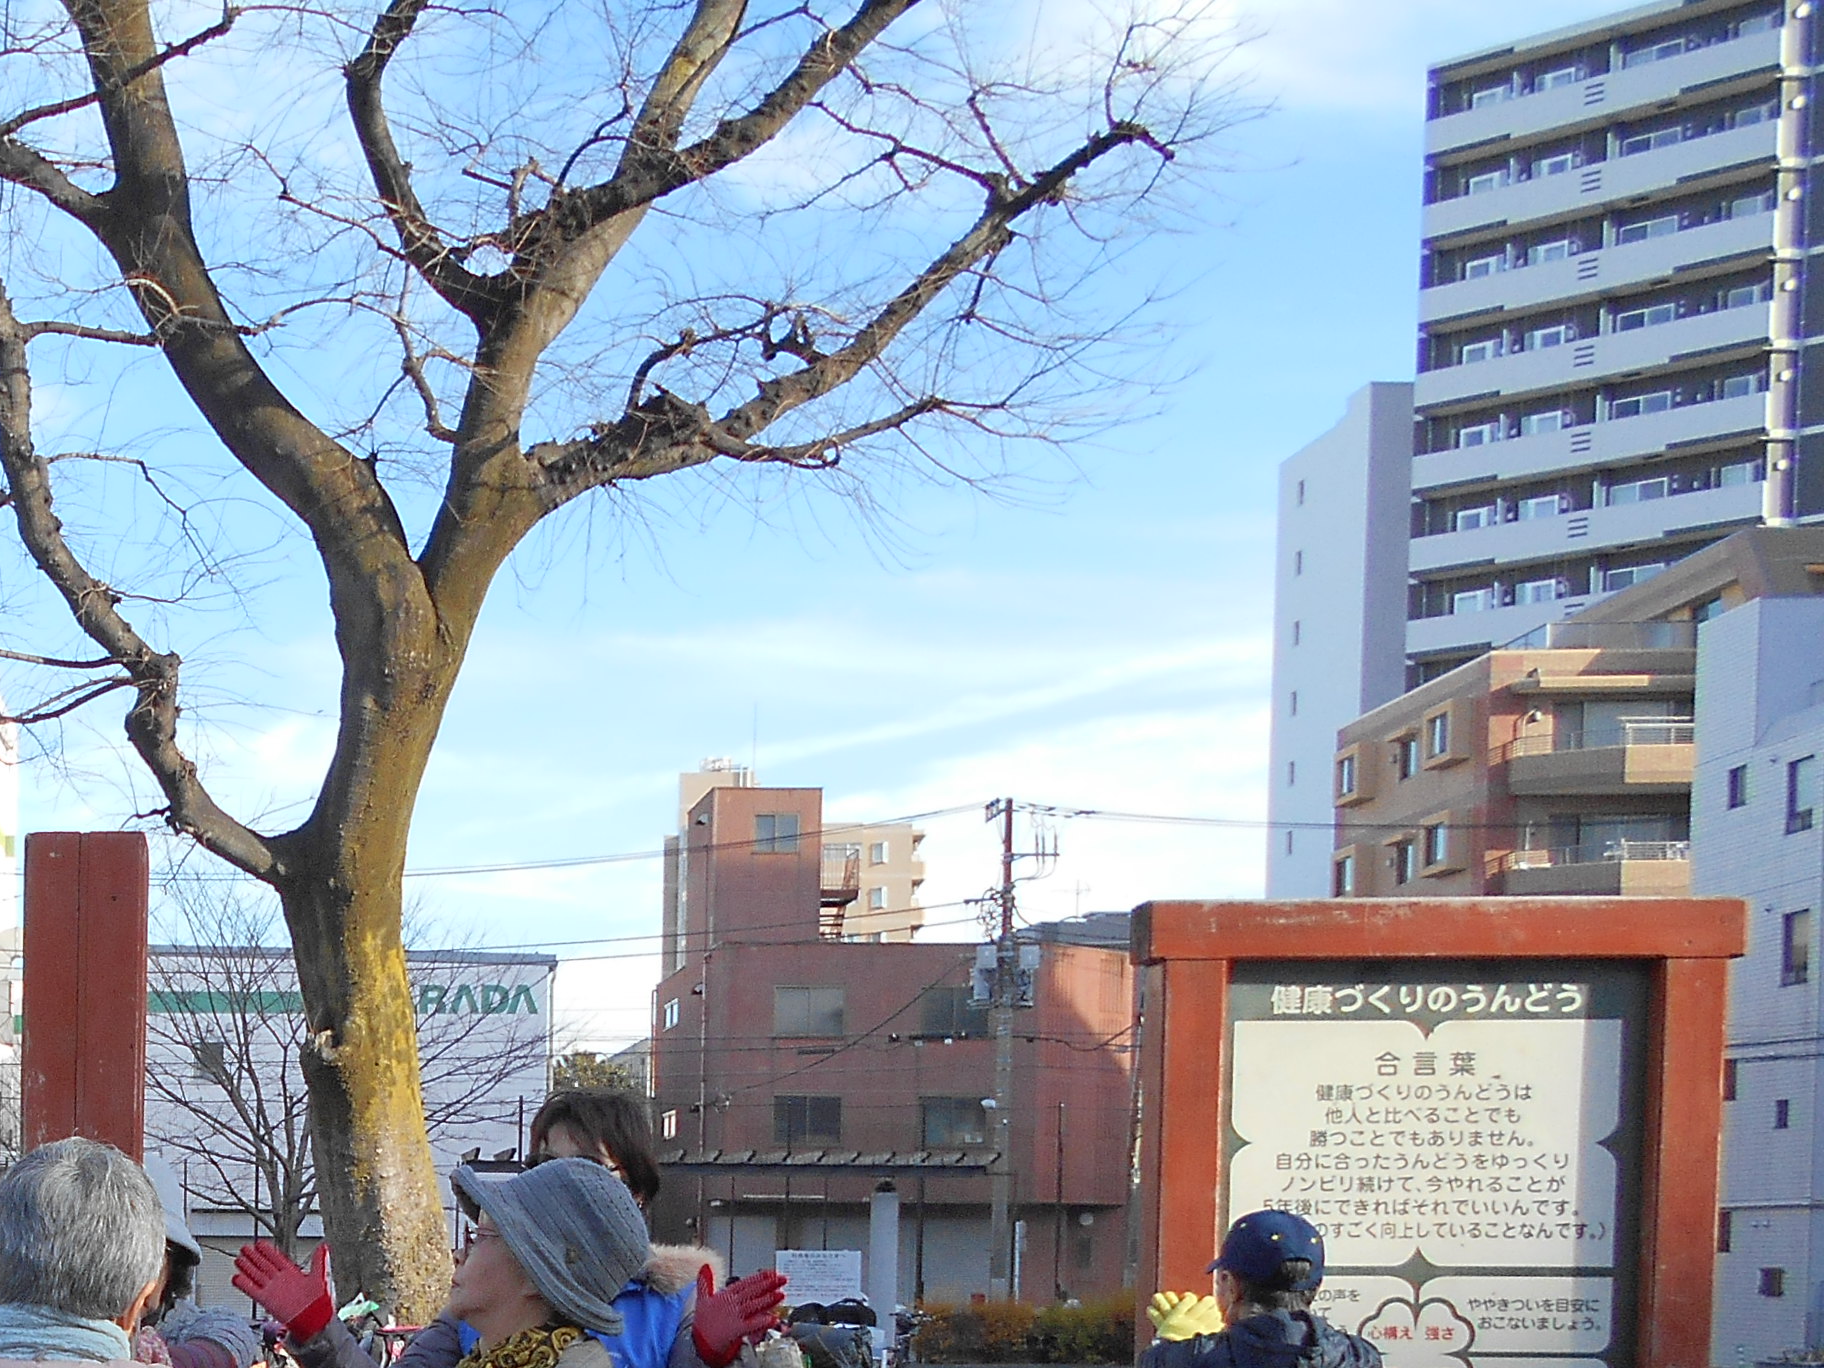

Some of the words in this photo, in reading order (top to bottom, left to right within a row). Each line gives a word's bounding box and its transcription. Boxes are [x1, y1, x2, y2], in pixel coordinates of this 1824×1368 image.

[1269, 984, 1585, 1016] 健康づくりのうんどう
[1374, 1050, 1478, 1077] 合言葉
[1315, 1083, 1533, 1103] 健康づくりのうんどうは
[1324, 1105, 1523, 1125] 他人と比べることでも
[1308, 1129, 1536, 1148] 勝つことでもありません。
[1275, 1152, 1570, 1171] 自分に合ったうんどうをゆっくり
[1280, 1175, 1566, 1195] ノンビリ続けて、今やれることが
[1467, 1297, 1600, 1313] ややきついを目安に
[1368, 1325, 1414, 1341] 心構え
[1424, 1325, 1456, 1341] 強さ
[1477, 1315, 1602, 1332] おこないましょう。
